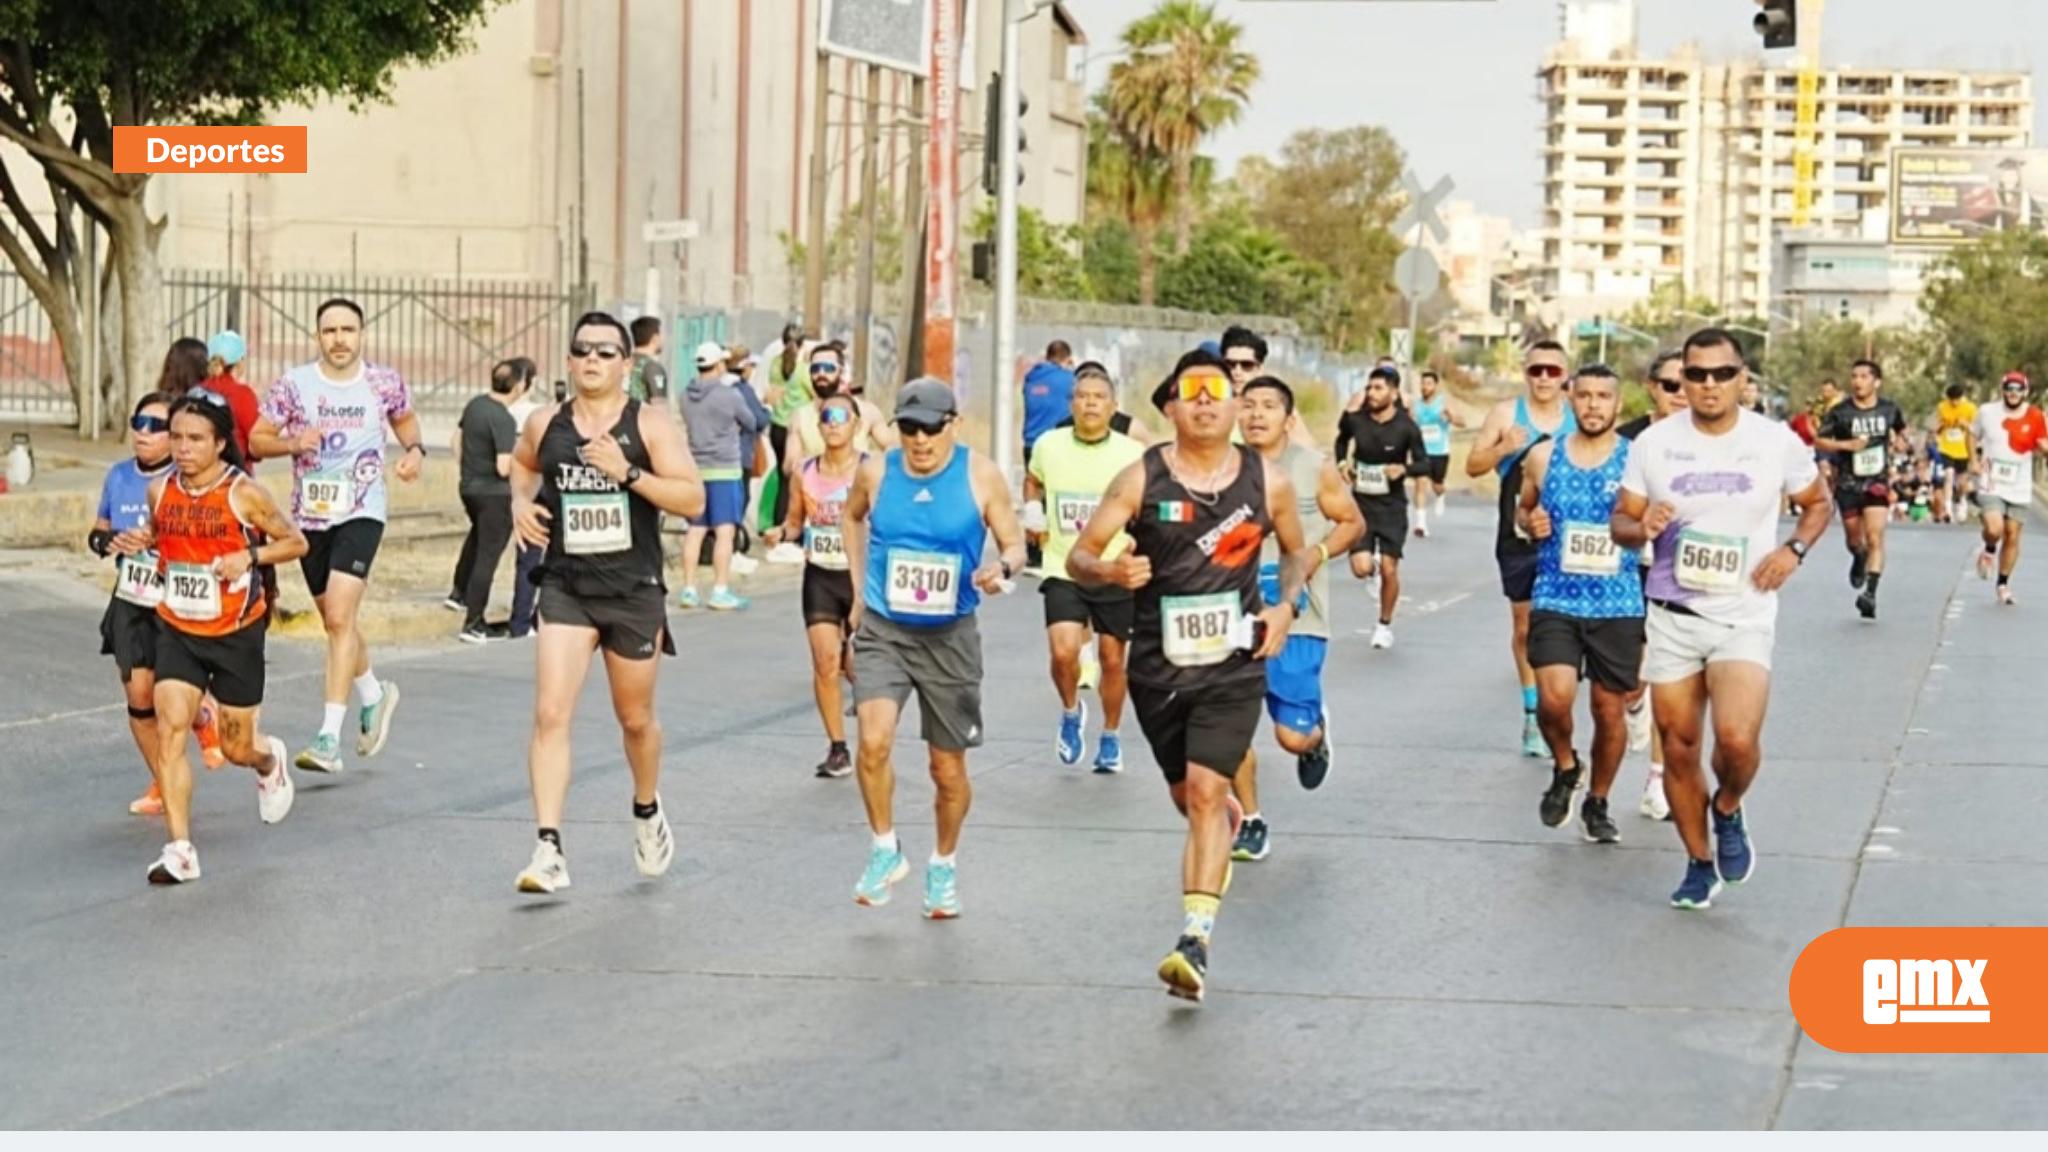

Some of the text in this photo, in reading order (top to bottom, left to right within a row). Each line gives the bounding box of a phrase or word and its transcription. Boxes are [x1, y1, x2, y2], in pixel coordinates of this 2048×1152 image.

[1852, 416, 1886, 433] ALTO
[158, 521, 190, 537] RACK
[569, 507, 622, 531] 3004
[1683, 544, 1738, 572] 5649
[127, 563, 162, 588] 1474
[173, 575, 209, 599] 1522
[895, 565, 949, 592] 3310
[1175, 610, 1229, 639] 1887
